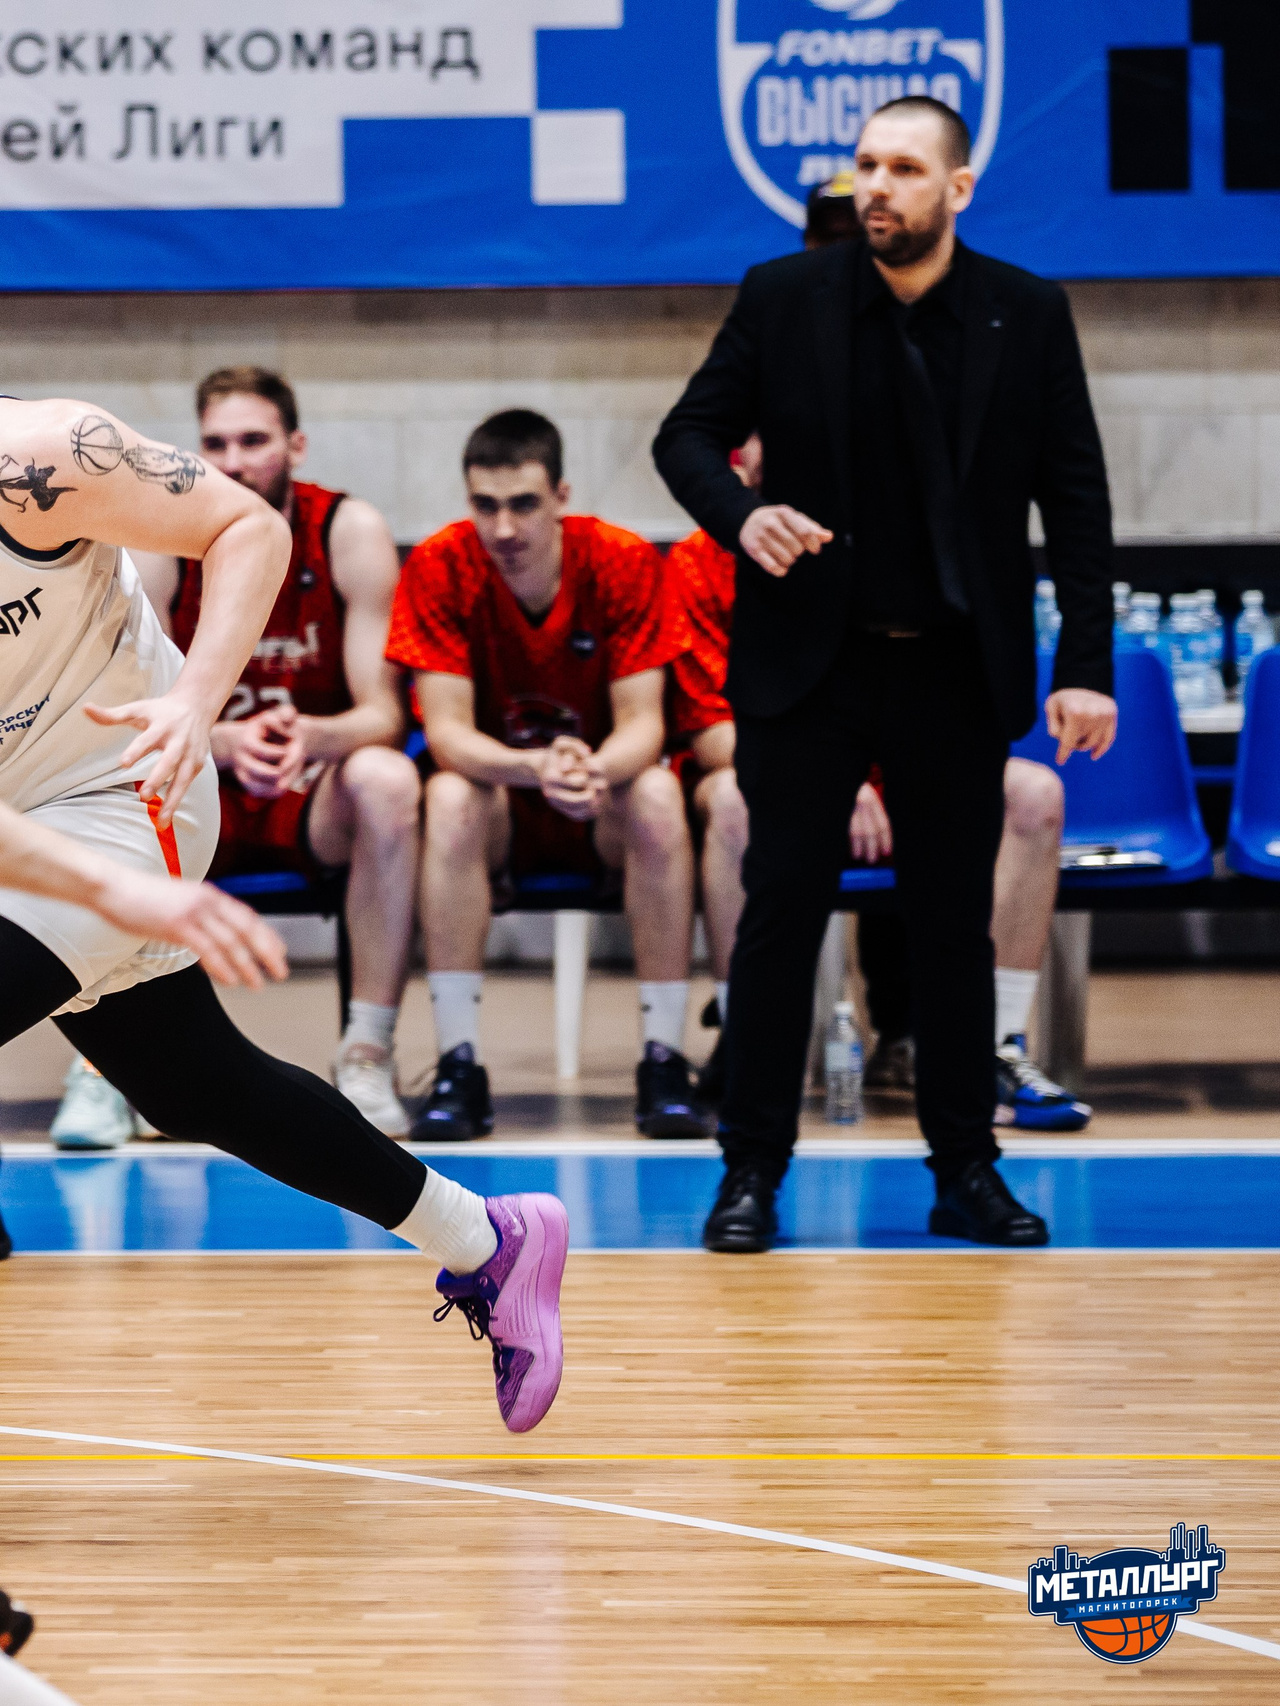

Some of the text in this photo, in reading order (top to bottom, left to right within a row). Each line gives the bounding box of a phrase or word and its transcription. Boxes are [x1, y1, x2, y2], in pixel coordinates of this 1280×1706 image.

[202, 27, 482, 81] команд
[776, 28, 943, 66] FONBET
[114, 104, 287, 161] Лиги
